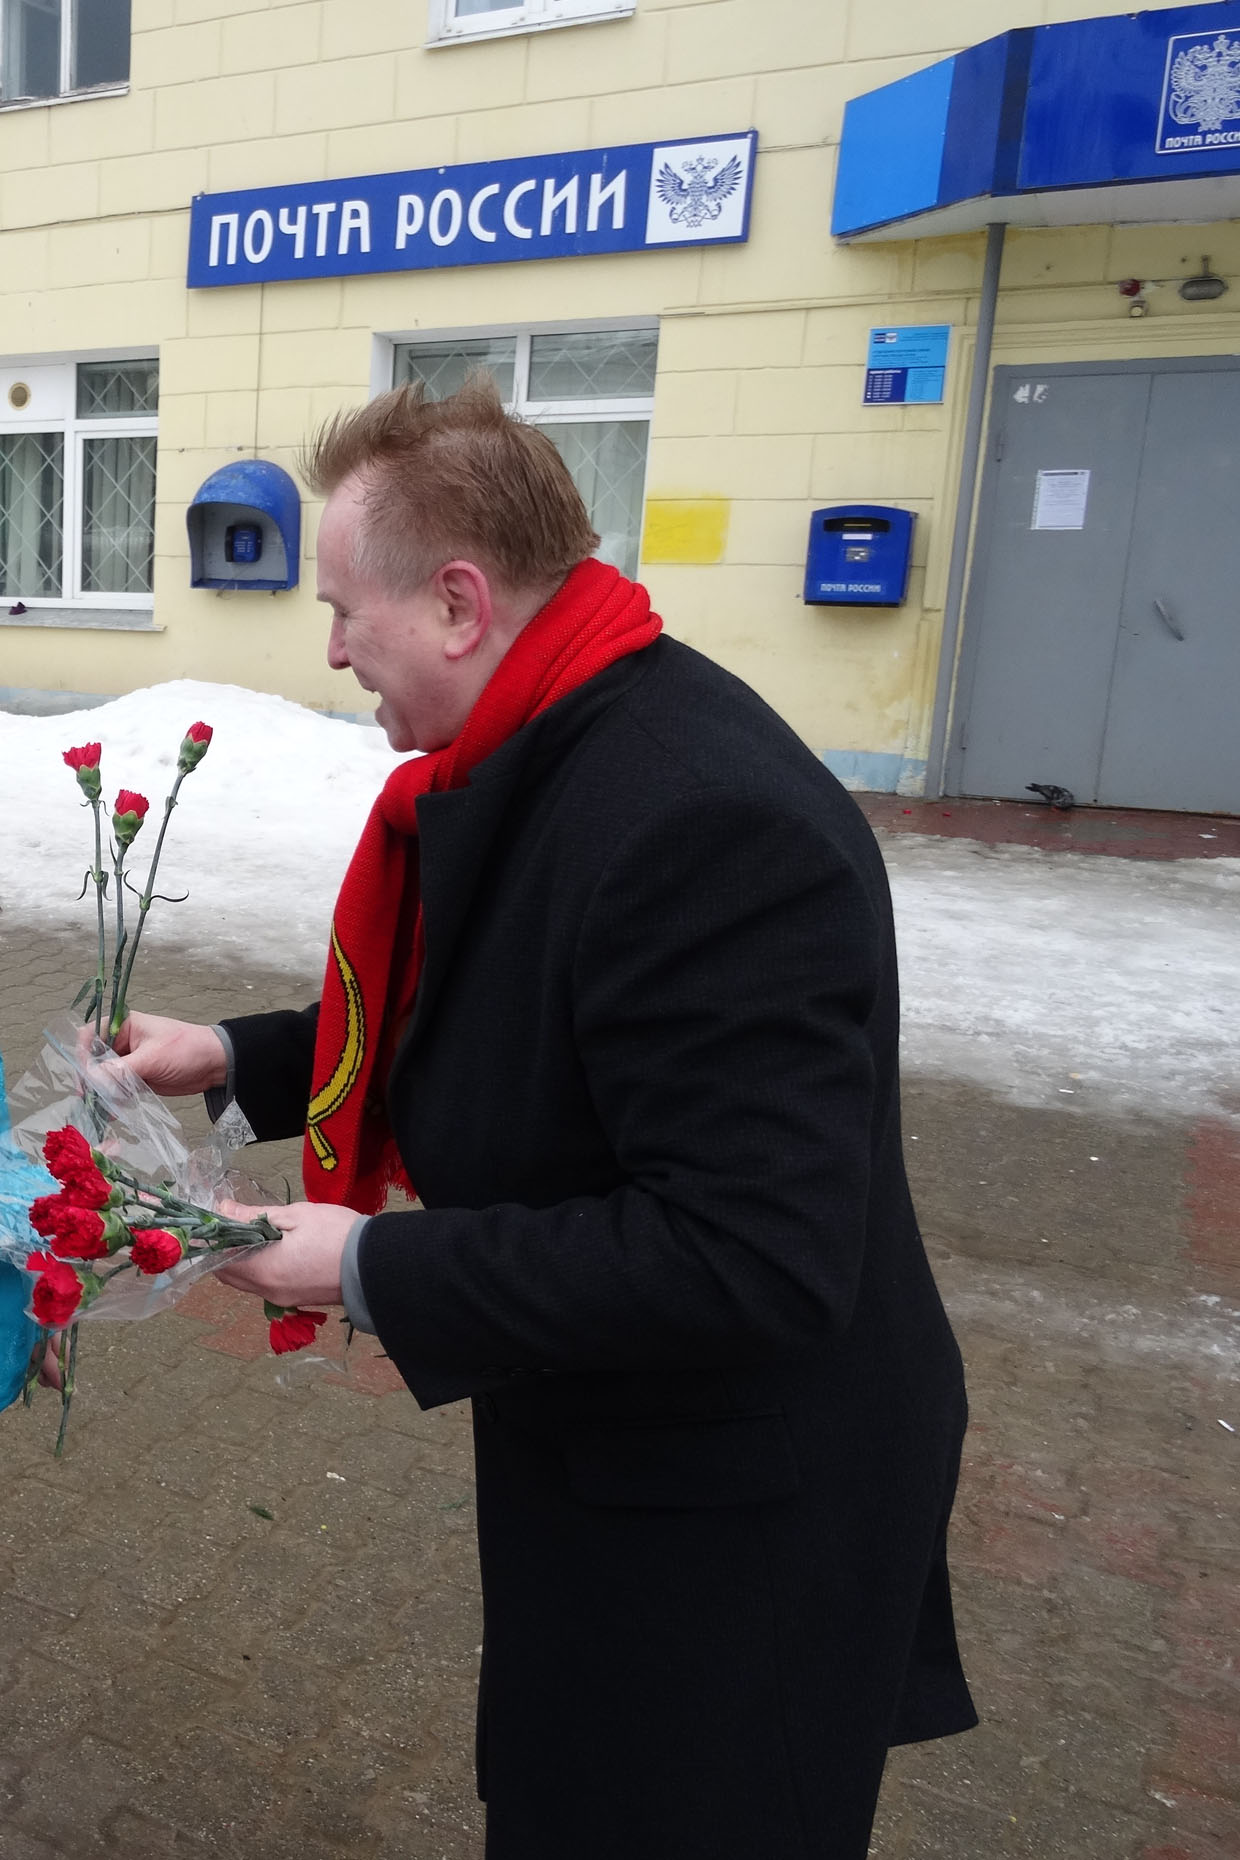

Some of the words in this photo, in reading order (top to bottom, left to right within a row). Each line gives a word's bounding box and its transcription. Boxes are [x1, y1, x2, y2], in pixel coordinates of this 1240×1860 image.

[1165, 135, 1202, 148] ПОЧТА
[208, 200, 371, 267] ПОЧТА
[395, 169, 627, 250] РОССИИ
